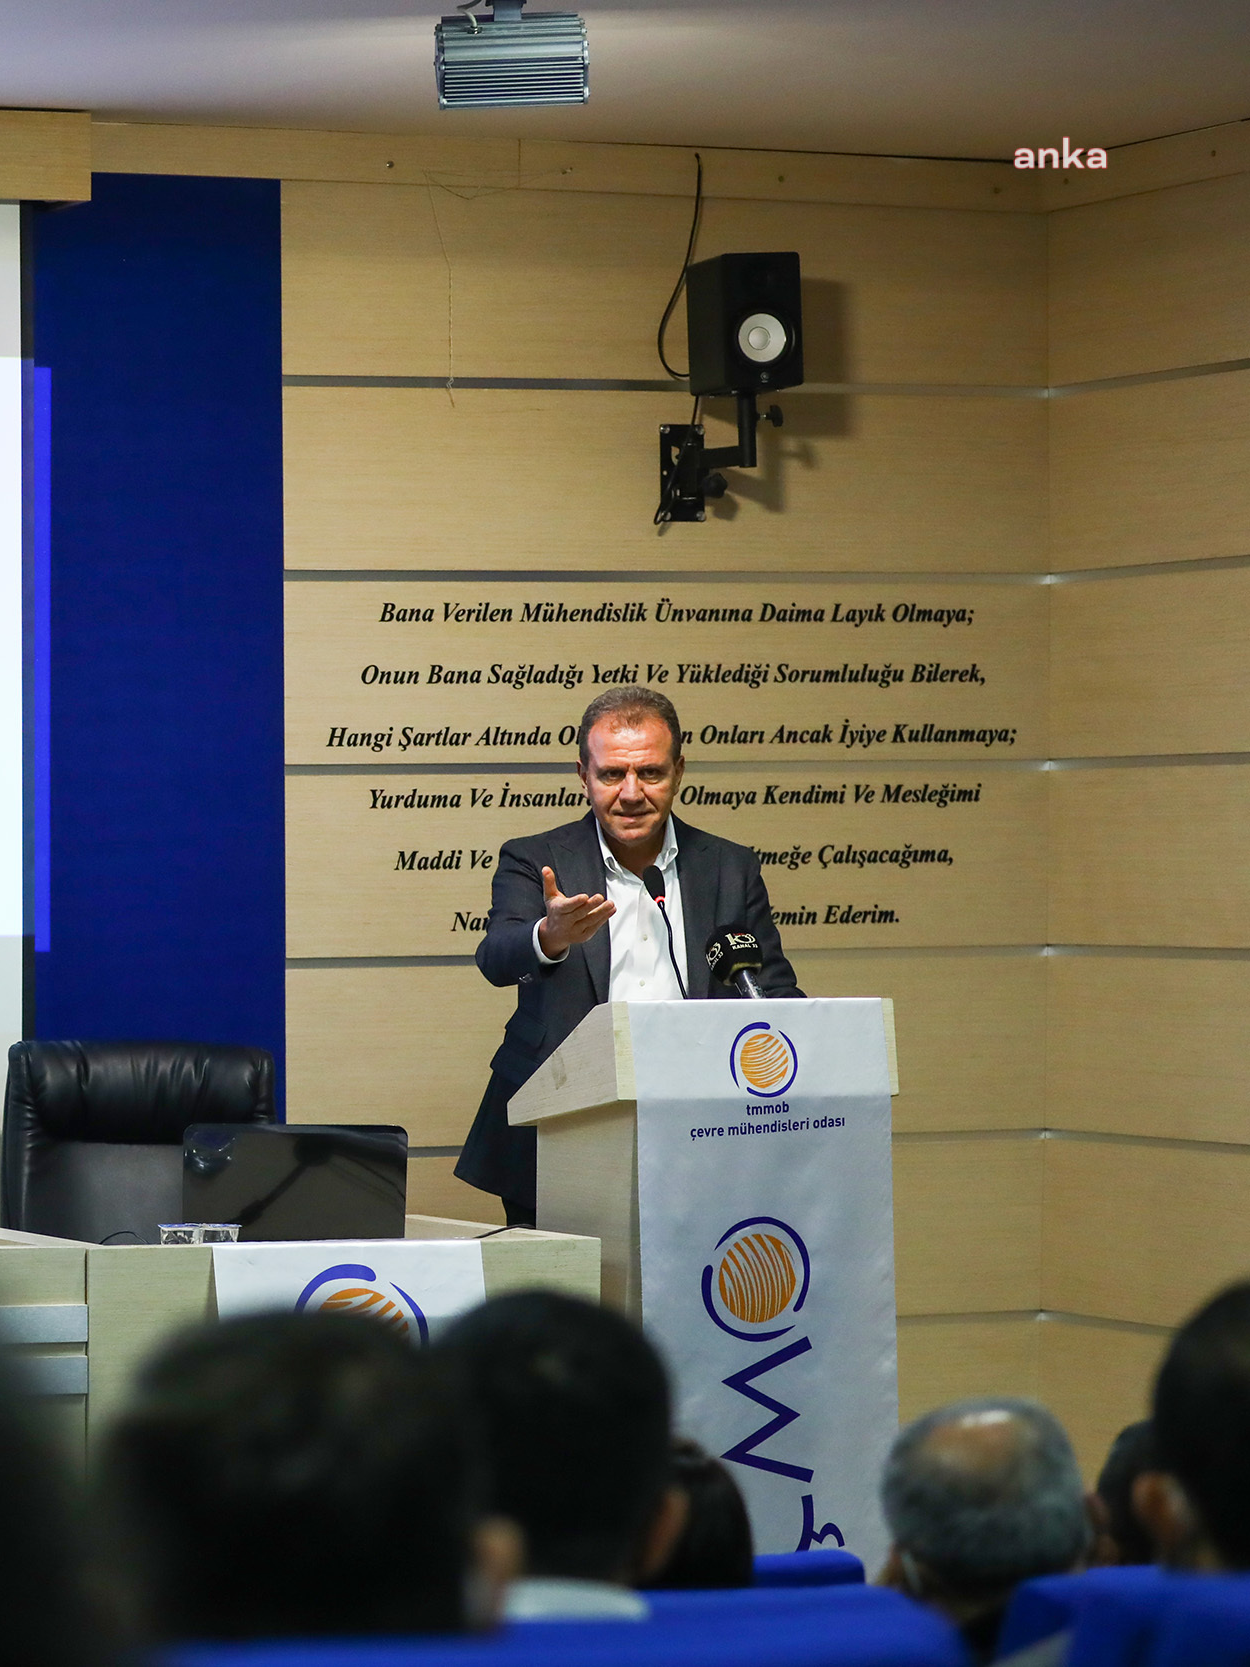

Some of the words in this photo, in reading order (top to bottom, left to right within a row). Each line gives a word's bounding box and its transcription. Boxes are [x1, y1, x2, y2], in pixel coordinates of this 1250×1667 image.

[379, 602, 435, 623] Bana
[443, 602, 513, 623] Verilen
[519, 602, 648, 623] Mühendislik
[655, 597, 754, 623] Ünvanına
[758, 602, 826, 623] Daima
[830, 602, 886, 628] Layık
[891, 602, 975, 629] Olmaya;
[361, 664, 420, 685] Onun
[426, 664, 482, 685] Bana
[487, 663, 584, 690] Sağladığı
[591, 663, 640, 684] Yetki
[647, 663, 670, 684] Ve
[677, 663, 770, 689] Yüklediği
[773, 663, 905, 689] Sorumluluğu
[909, 662, 986, 686] Bilerek,
[326, 726, 394, 753] Hangi
[398, 726, 472, 752] Şartlar
[474, 725, 552, 746] Altında
[699, 724, 765, 745] Onları
[768, 723, 834, 744] Ancak
[838, 718, 888, 749] İyiye
[890, 723, 1018, 748] Kullanmaya;
[369, 788, 462, 810] Yurduma
[470, 788, 494, 808] Ve
[679, 785, 757, 811] Olmaya
[762, 783, 847, 805] Kendimi
[854, 784, 876, 804] Ve
[880, 782, 982, 809] Mesleğimi
[394, 849, 463, 871] Maddi
[470, 849, 493, 870] Ve
[817, 843, 954, 870] Çalışacağıma,
[770, 905, 818, 926] emin
[822, 903, 900, 925] Ederim.
[746, 1101, 789, 1116] tmmob
[690, 1126, 725, 1141] çevre
[727, 1117, 810, 1136] mühendisleri
[812, 1116, 845, 1129] odası
